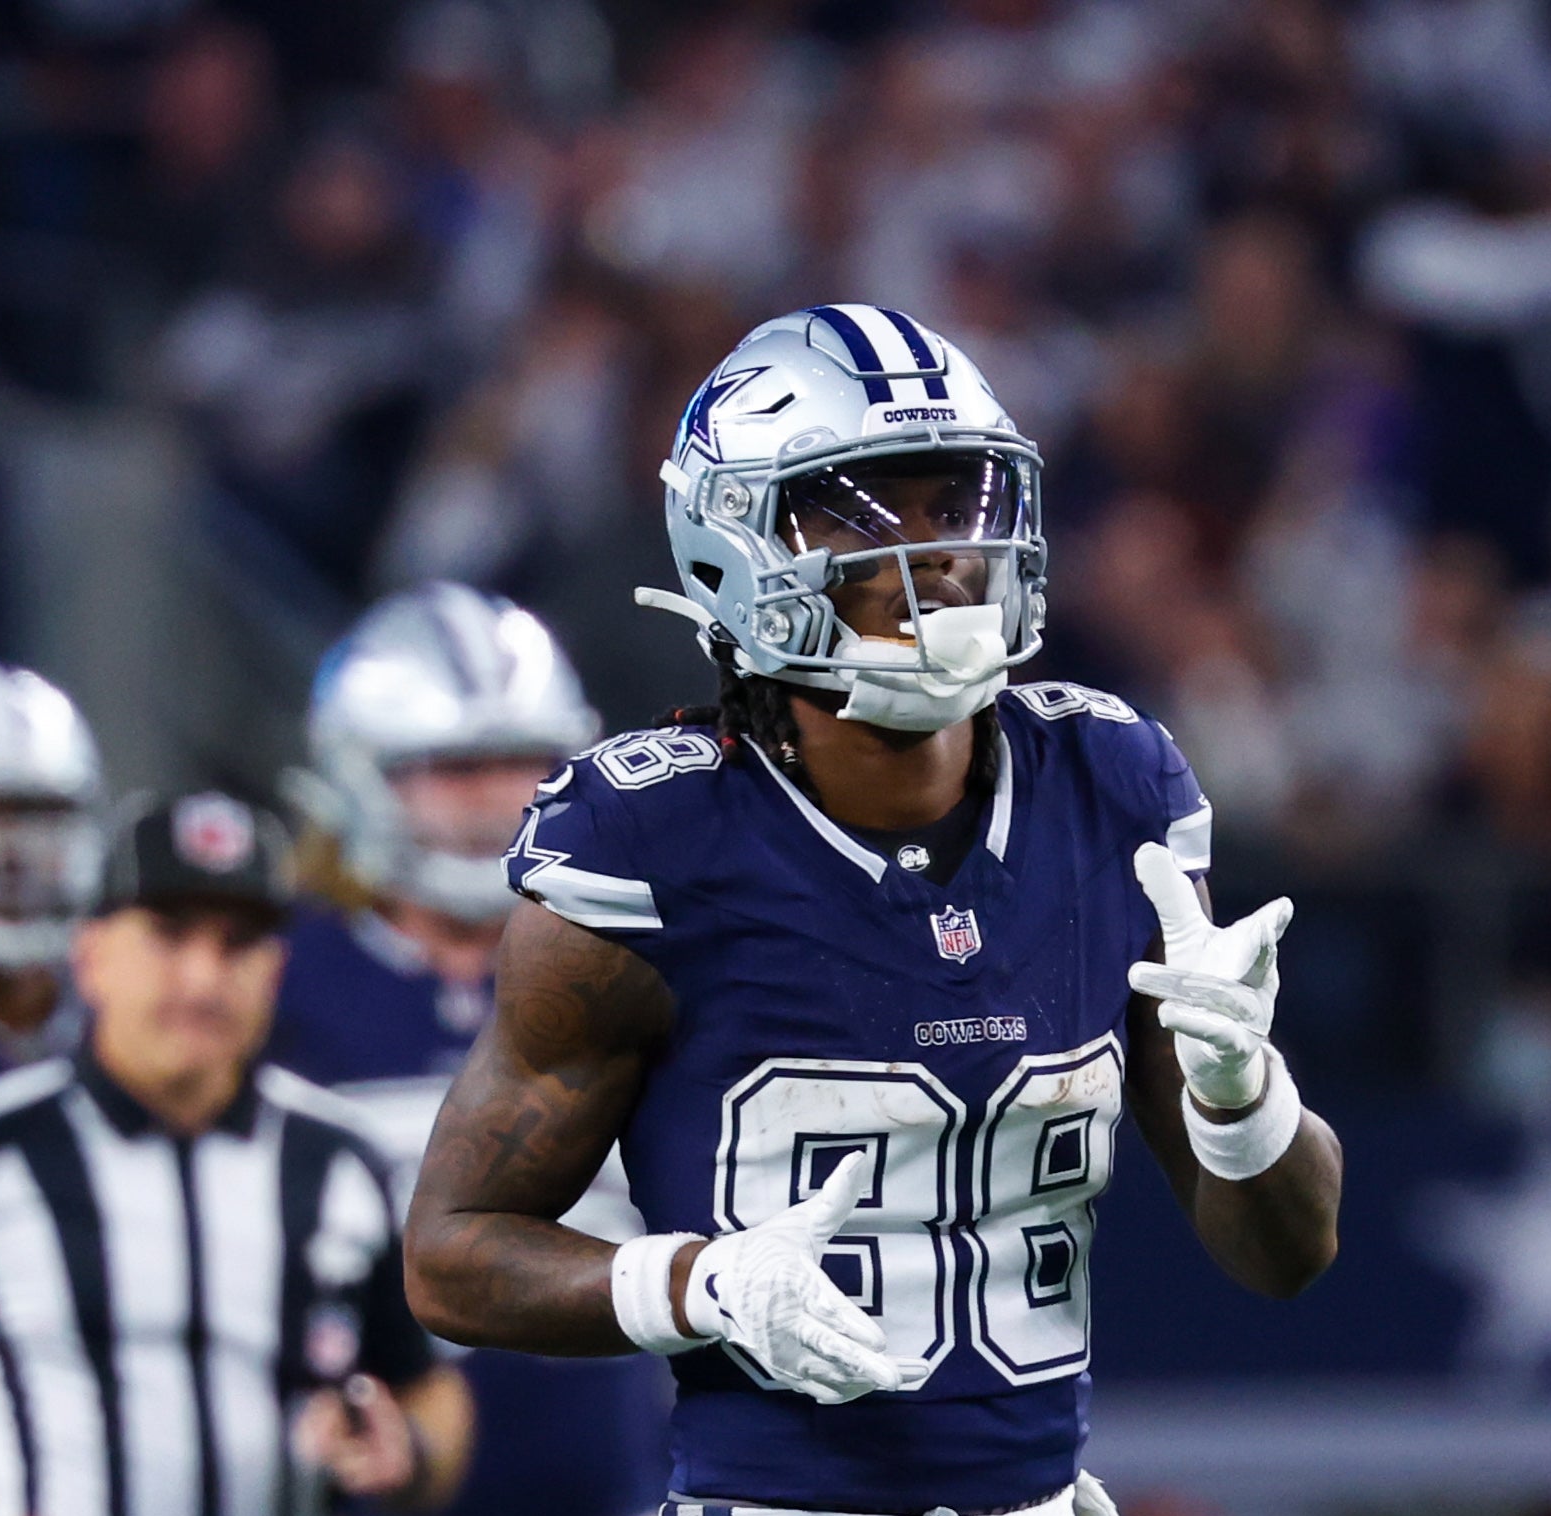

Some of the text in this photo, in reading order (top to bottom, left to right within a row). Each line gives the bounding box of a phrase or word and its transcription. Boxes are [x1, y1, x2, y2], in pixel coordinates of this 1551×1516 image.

[883, 408, 957, 423] COWBOYS
[943, 929, 975, 953] NFL
[914, 1016, 1027, 1046] COWBOYS
[713, 1029, 1125, 1391] 88
